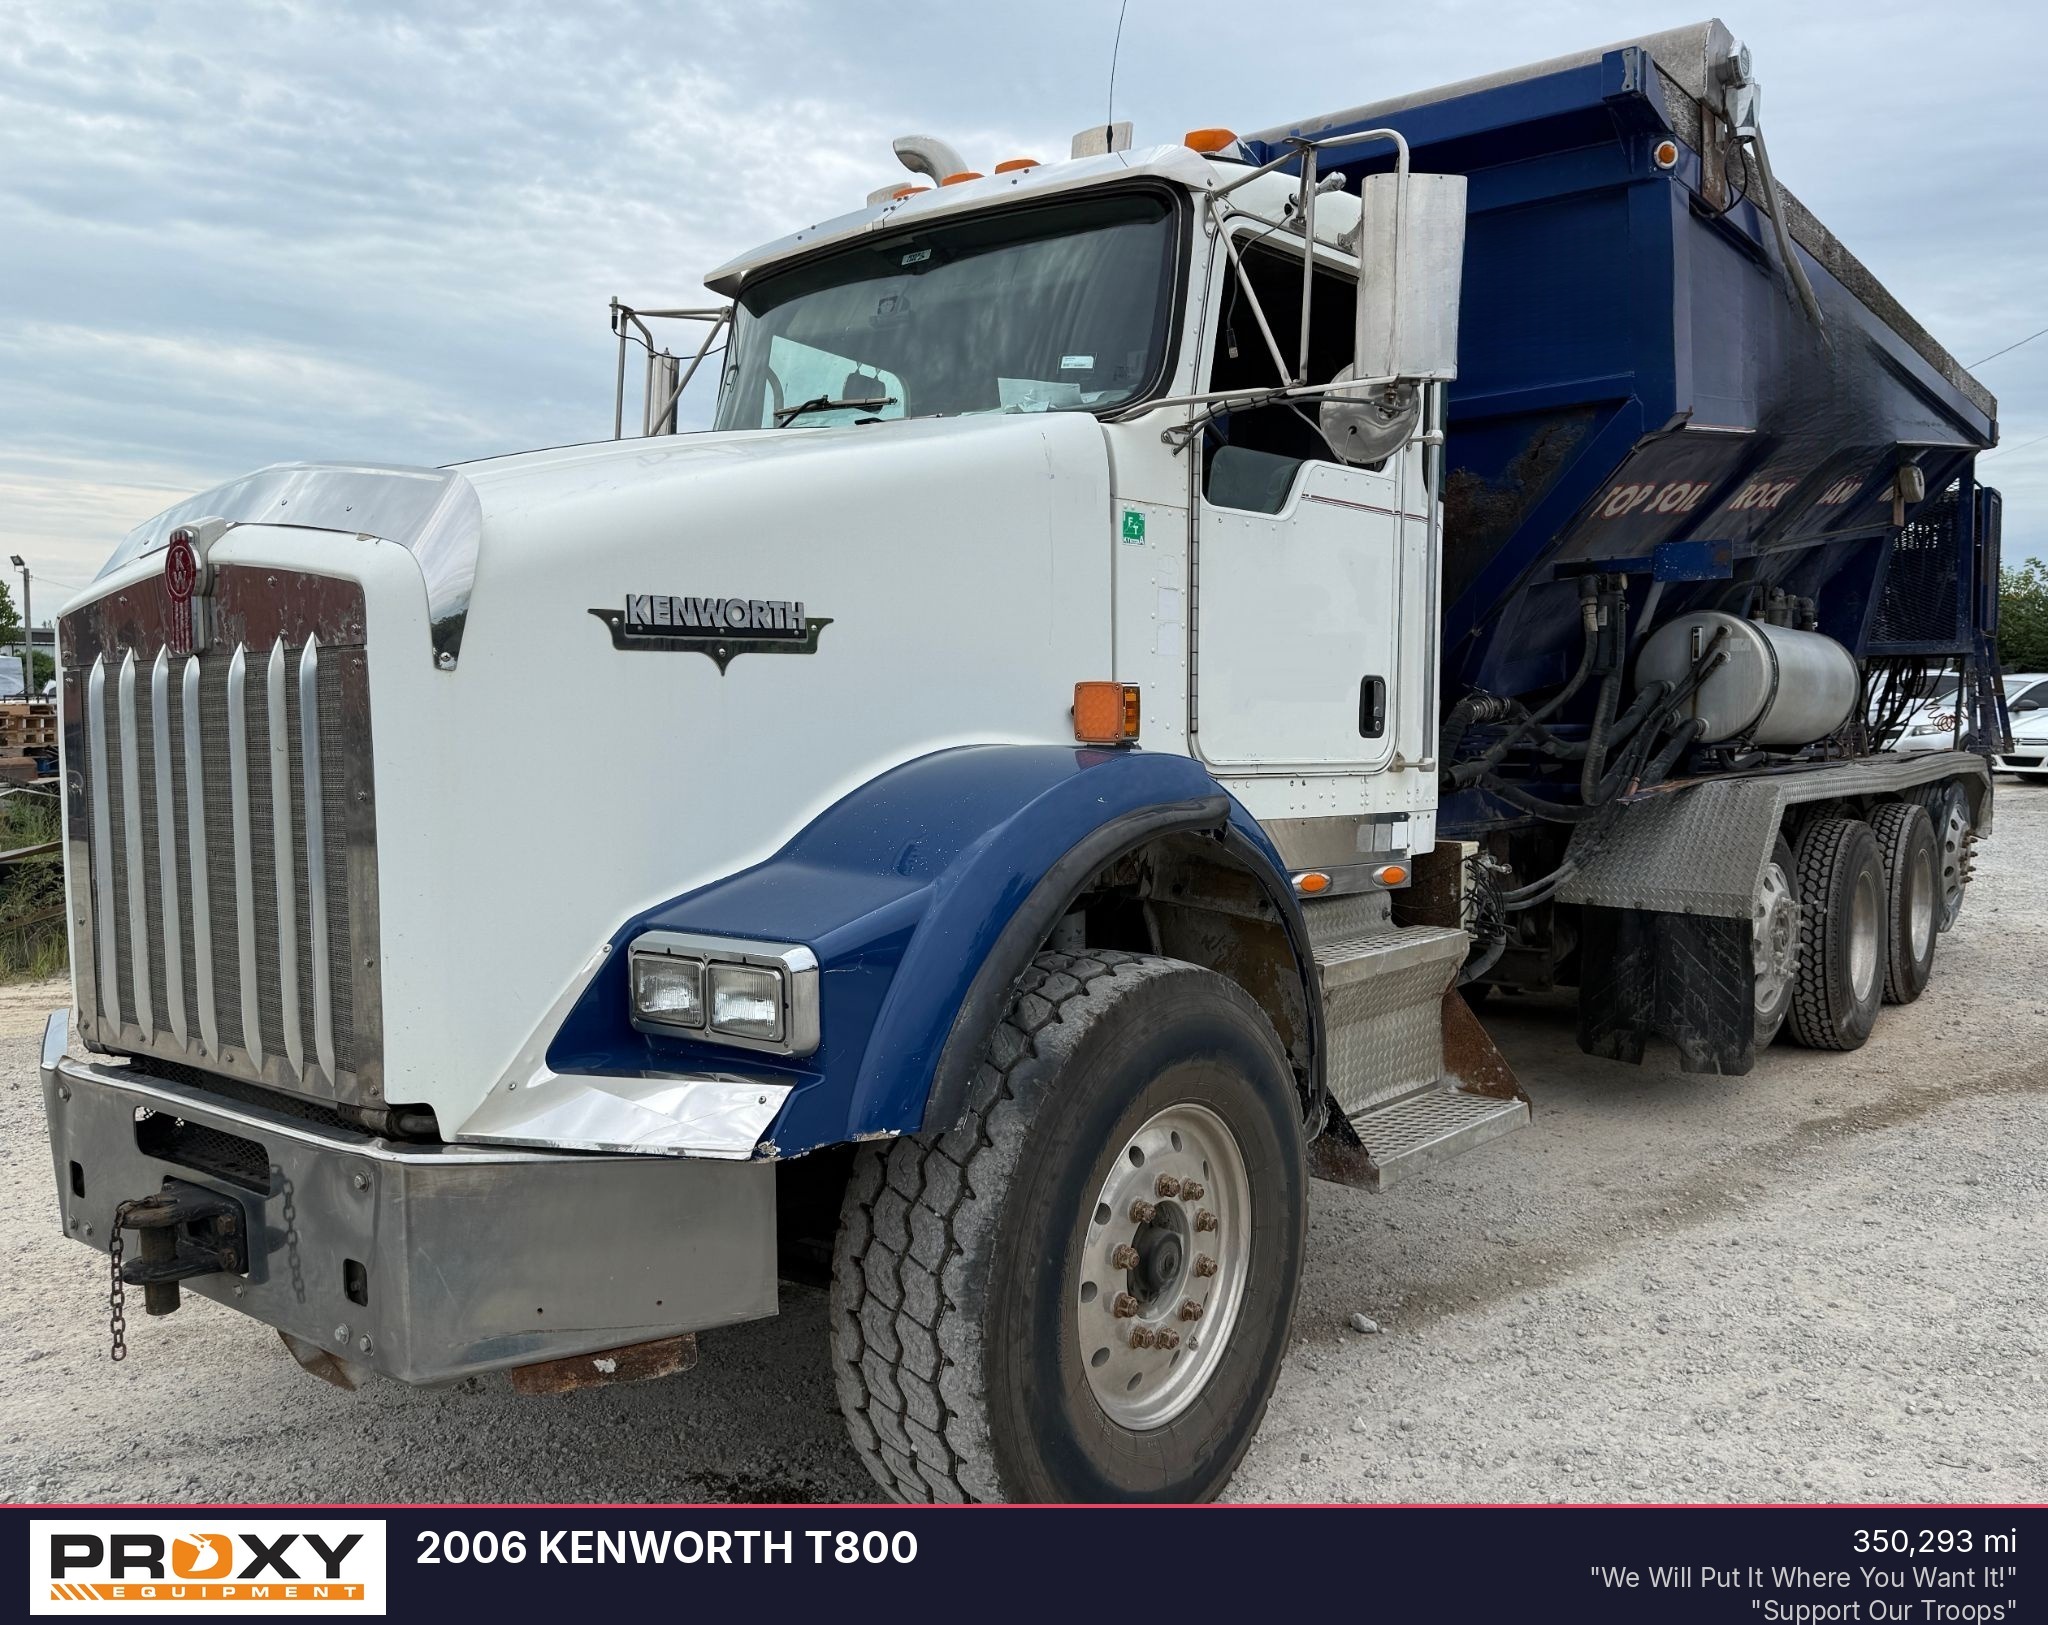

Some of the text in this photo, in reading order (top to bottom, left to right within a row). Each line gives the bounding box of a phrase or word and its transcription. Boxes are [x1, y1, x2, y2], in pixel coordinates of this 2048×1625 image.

[1590, 480, 1712, 519] TOP SOIL
[1728, 478, 1798, 511] ROCK
[626, 594, 805, 631] KENWORTH
